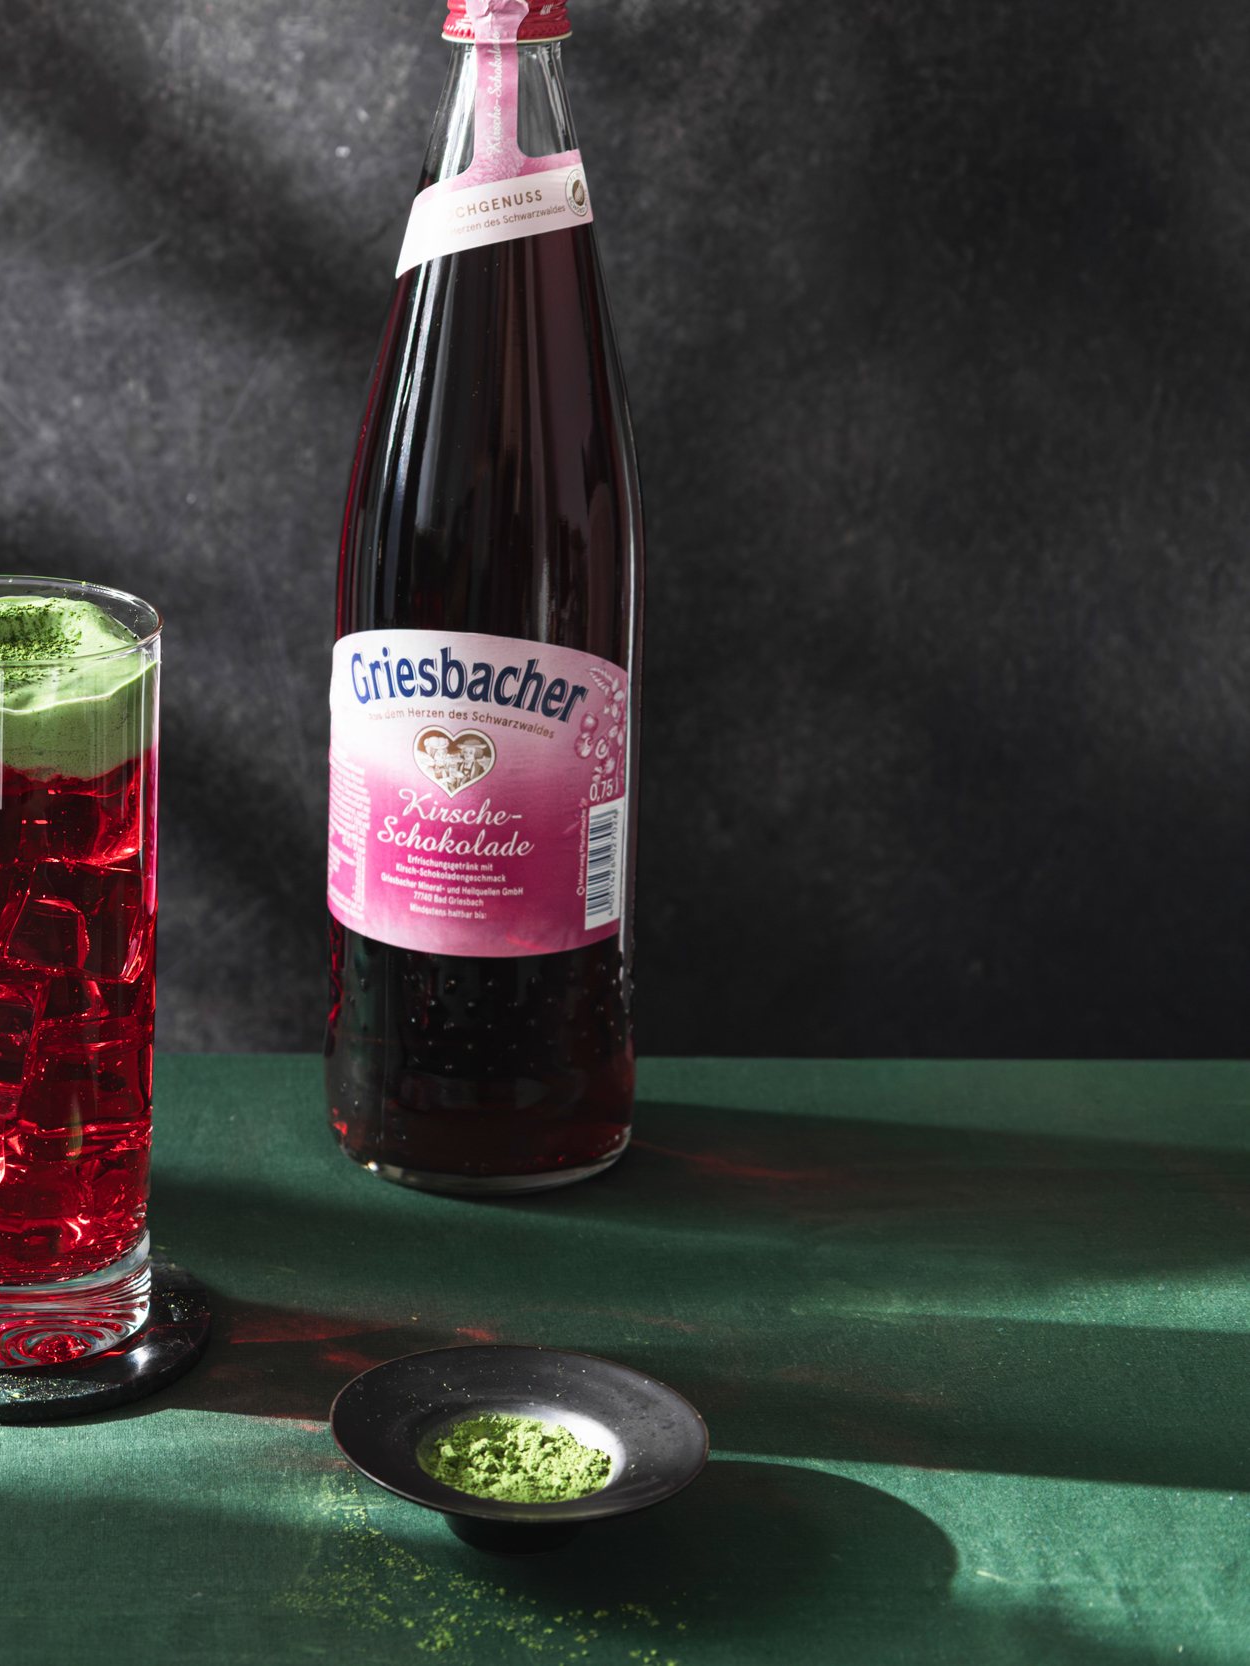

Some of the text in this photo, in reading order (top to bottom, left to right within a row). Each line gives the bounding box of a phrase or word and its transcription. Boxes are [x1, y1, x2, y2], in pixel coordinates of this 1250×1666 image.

[484, 217, 501, 228] des
[503, 204, 566, 224] Schwarzwaldes
[351, 646, 589, 723] Griesbacher
[385, 709, 405, 719] dem
[408, 708, 445, 718] Herzen
[449, 709, 468, 720] des
[471, 711, 555, 739] Schwarzwaldes
[398, 788, 522, 825] Kirsche-
[377, 816, 535, 857] Schokolade
[396, 863, 506, 883] Kirsch-Schokoladengeschmack
[407, 854, 493, 871] Erfrischungsgetränk mit
[381, 872, 524, 897] Griesbacher Mineral- und Heilquellen GmbH
[410, 903, 446, 917] Mindestens
[448, 910, 472, 919] haltbar
[434, 894, 447, 904] Bad
[448, 896, 484, 907] Griesbach
